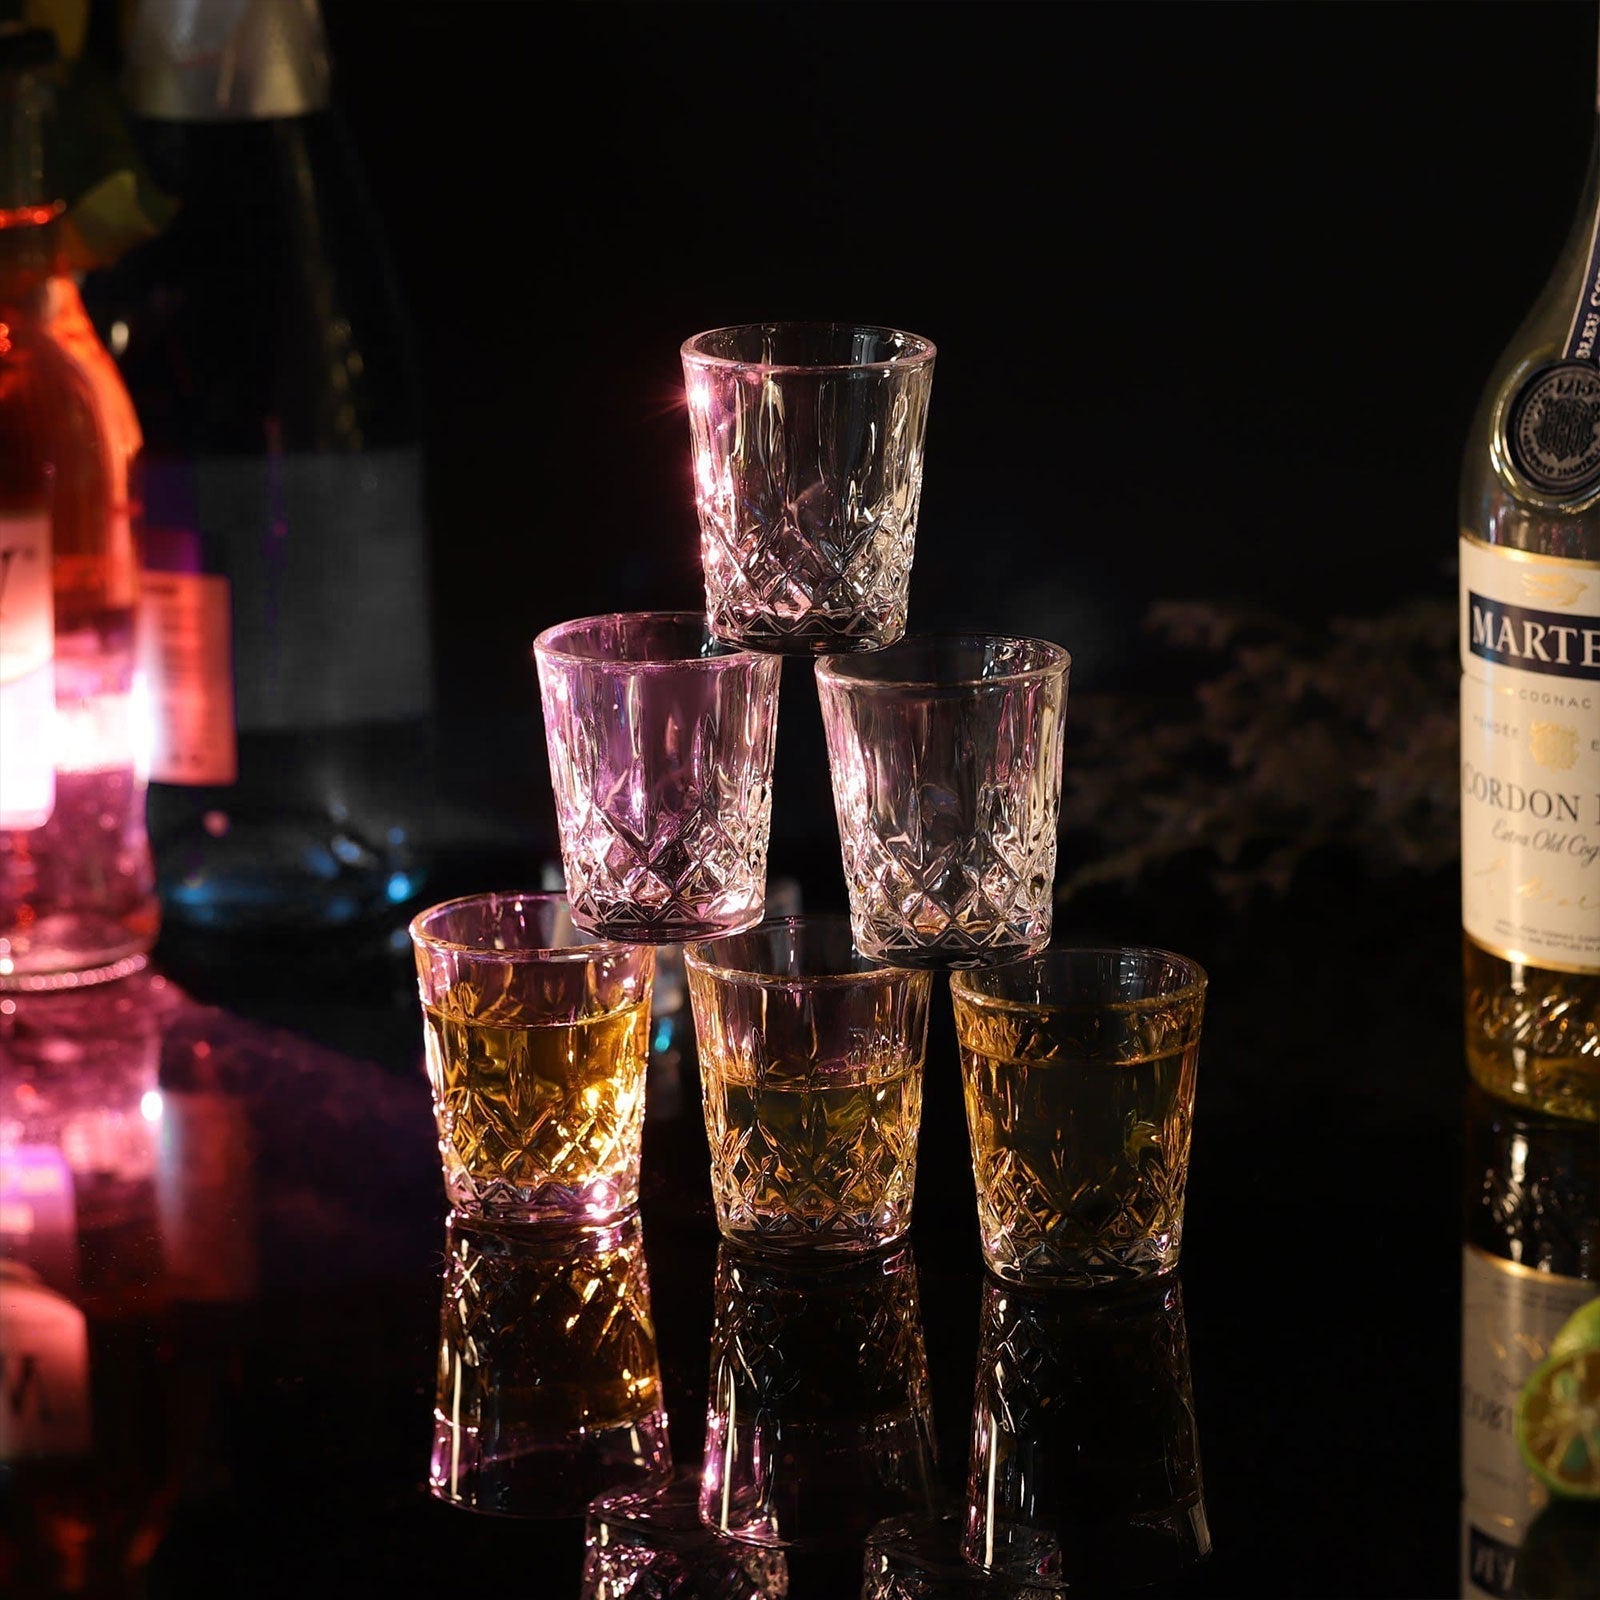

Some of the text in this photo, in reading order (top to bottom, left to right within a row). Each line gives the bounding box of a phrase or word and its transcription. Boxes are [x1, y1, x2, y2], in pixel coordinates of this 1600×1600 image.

[1472, 604, 1600, 668] MARTE
[1519, 689, 1592, 710] COGNAC
[1532, 828, 1567, 852] Old
